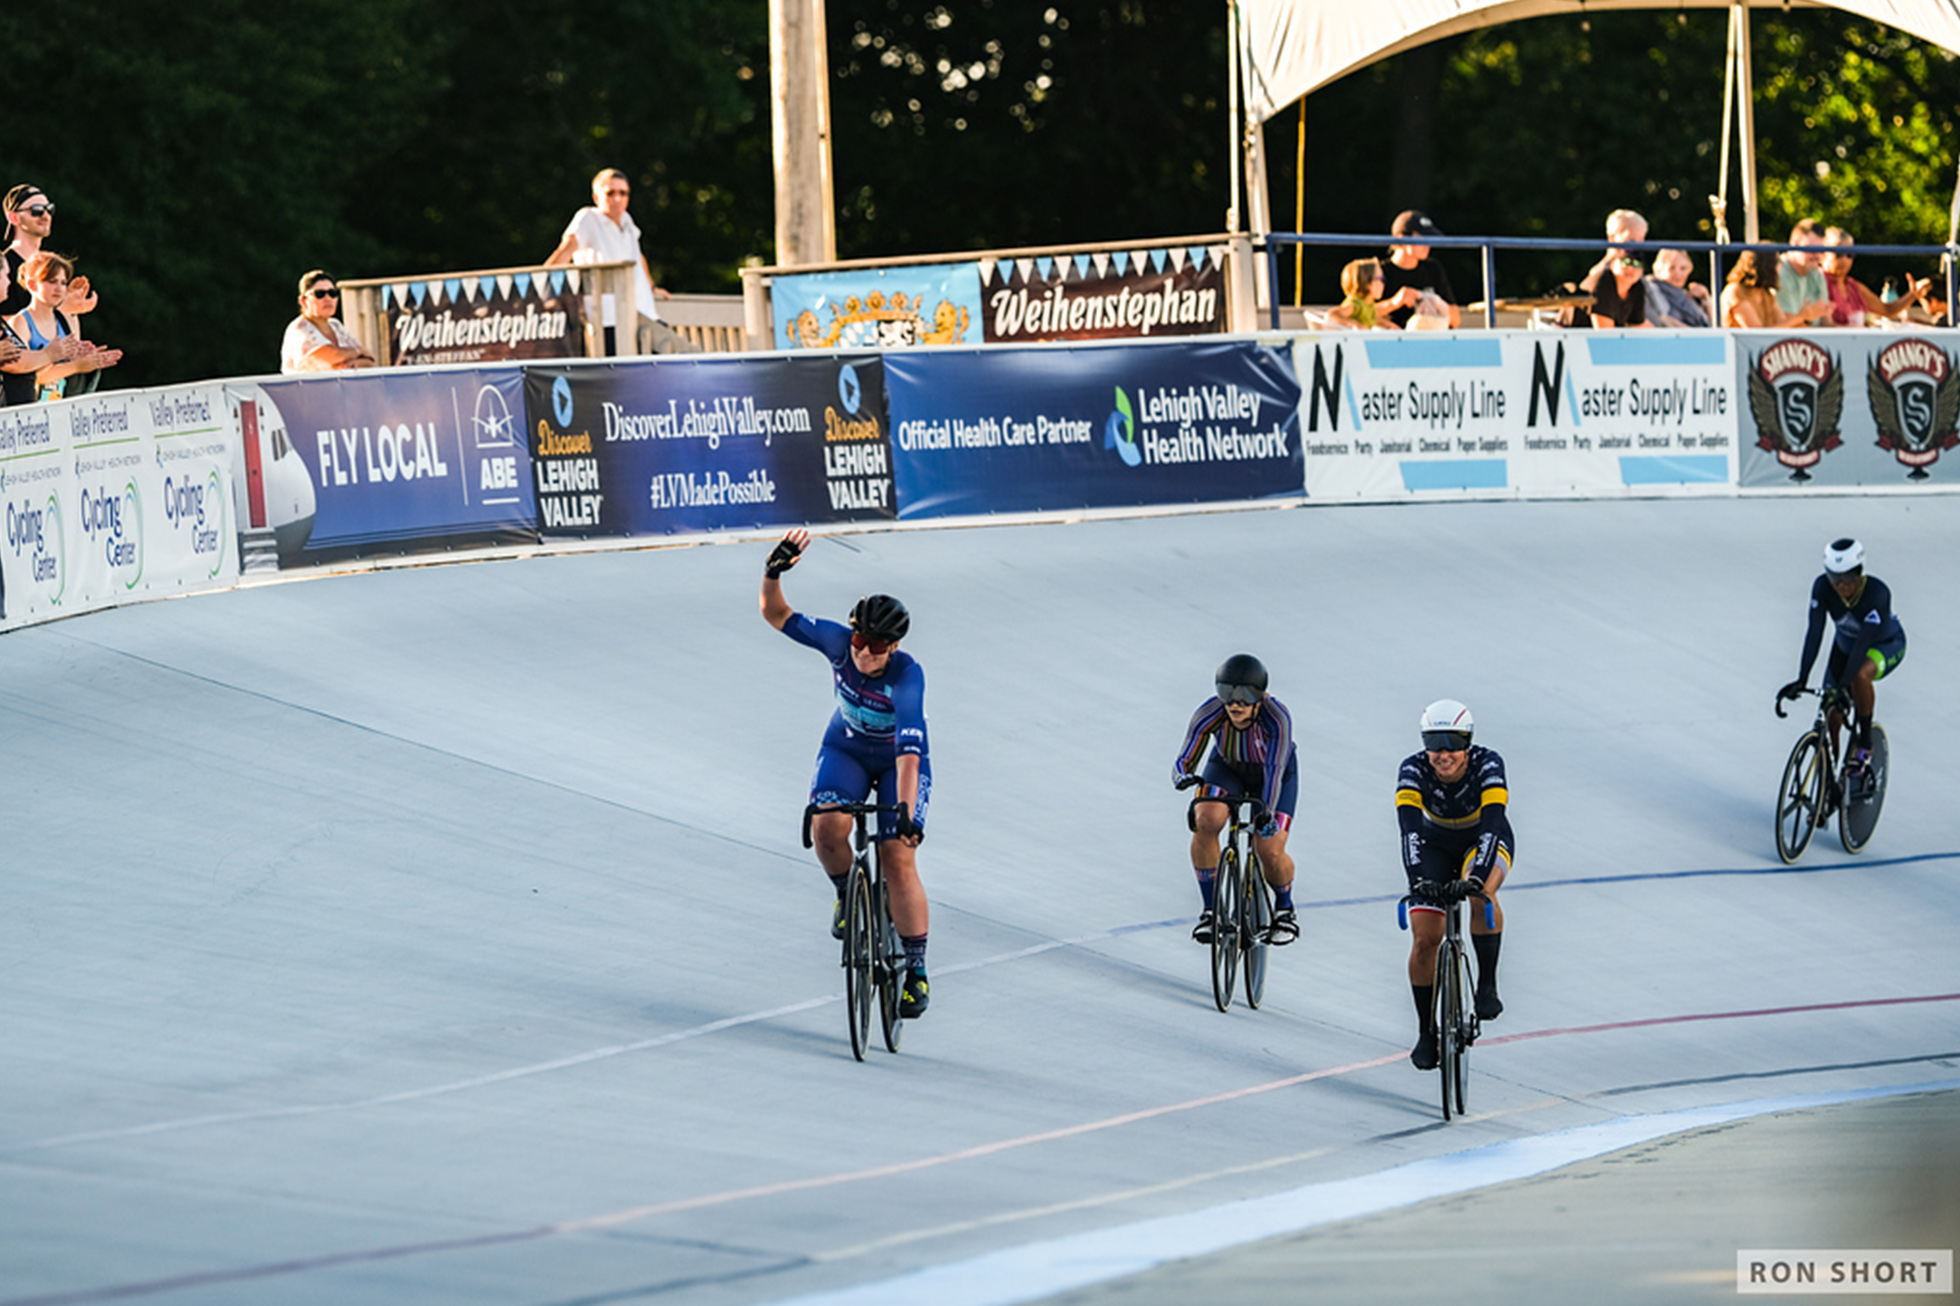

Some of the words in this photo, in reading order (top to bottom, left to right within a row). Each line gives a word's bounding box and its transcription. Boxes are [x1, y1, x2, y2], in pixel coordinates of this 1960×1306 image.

[990, 277, 1217, 337] Weihenstephan
[395, 303, 567, 350] Weihenstephan
[1761, 342, 1830, 379] SHANGY'S
[1880, 342, 1948, 379] SHANGY'S
[150, 398, 175, 430] Valley
[175, 394, 212, 426] Preferred
[1138, 387, 1201, 430] Lehigh
[1202, 384, 1262, 427] Valley
[1409, 381, 1465, 429] Supply
[1471, 380, 1506, 419] Line
[1628, 378, 1685, 426] Supply
[1691, 377, 1727, 415] Line
[0, 419, 16, 454] alley
[17, 413, 50, 447] Preferred
[69, 408, 92, 441] Valley
[92, 403, 129, 435] Preferred
[538, 419, 592, 456] Discover
[602, 397, 811, 450] DiscoverLehighValley.com
[825, 405, 881, 442] Discover
[899, 418, 950, 450] Official
[952, 417, 1001, 449] Health
[1002, 416, 1035, 446] Care
[1037, 415, 1092, 444] Partner
[316, 427, 358, 487] FLY
[363, 422, 448, 483] LOCAL
[1142, 427, 1205, 465] Health
[1206, 423, 1289, 462] Network
[1355, 439, 1373, 457] Party
[1419, 437, 1450, 453] Chemical
[1457, 437, 1477, 455] Paper
[1479, 436, 1509, 453] Supplies
[1573, 434, 1591, 451] Party
[1638, 433, 1670, 448] Chemical
[1677, 433, 1697, 449] Paper
[1699, 432, 1729, 448] Supplies
[480, 457, 518, 491] ABE
[536, 458, 599, 493] LEHIGH
[824, 444, 887, 477] LEHIGH
[164, 475, 204, 529] Cycling
[650, 469, 776, 509] #LVMadePossible
[826, 479, 890, 511] VALLEY
[7, 500, 44, 557] Cycling
[81, 486, 122, 542] Cycling
[540, 495, 603, 527] VALLEY
[106, 536, 136, 567] Center
[192, 523, 218, 554] Center
[33, 551, 56, 582] Center
